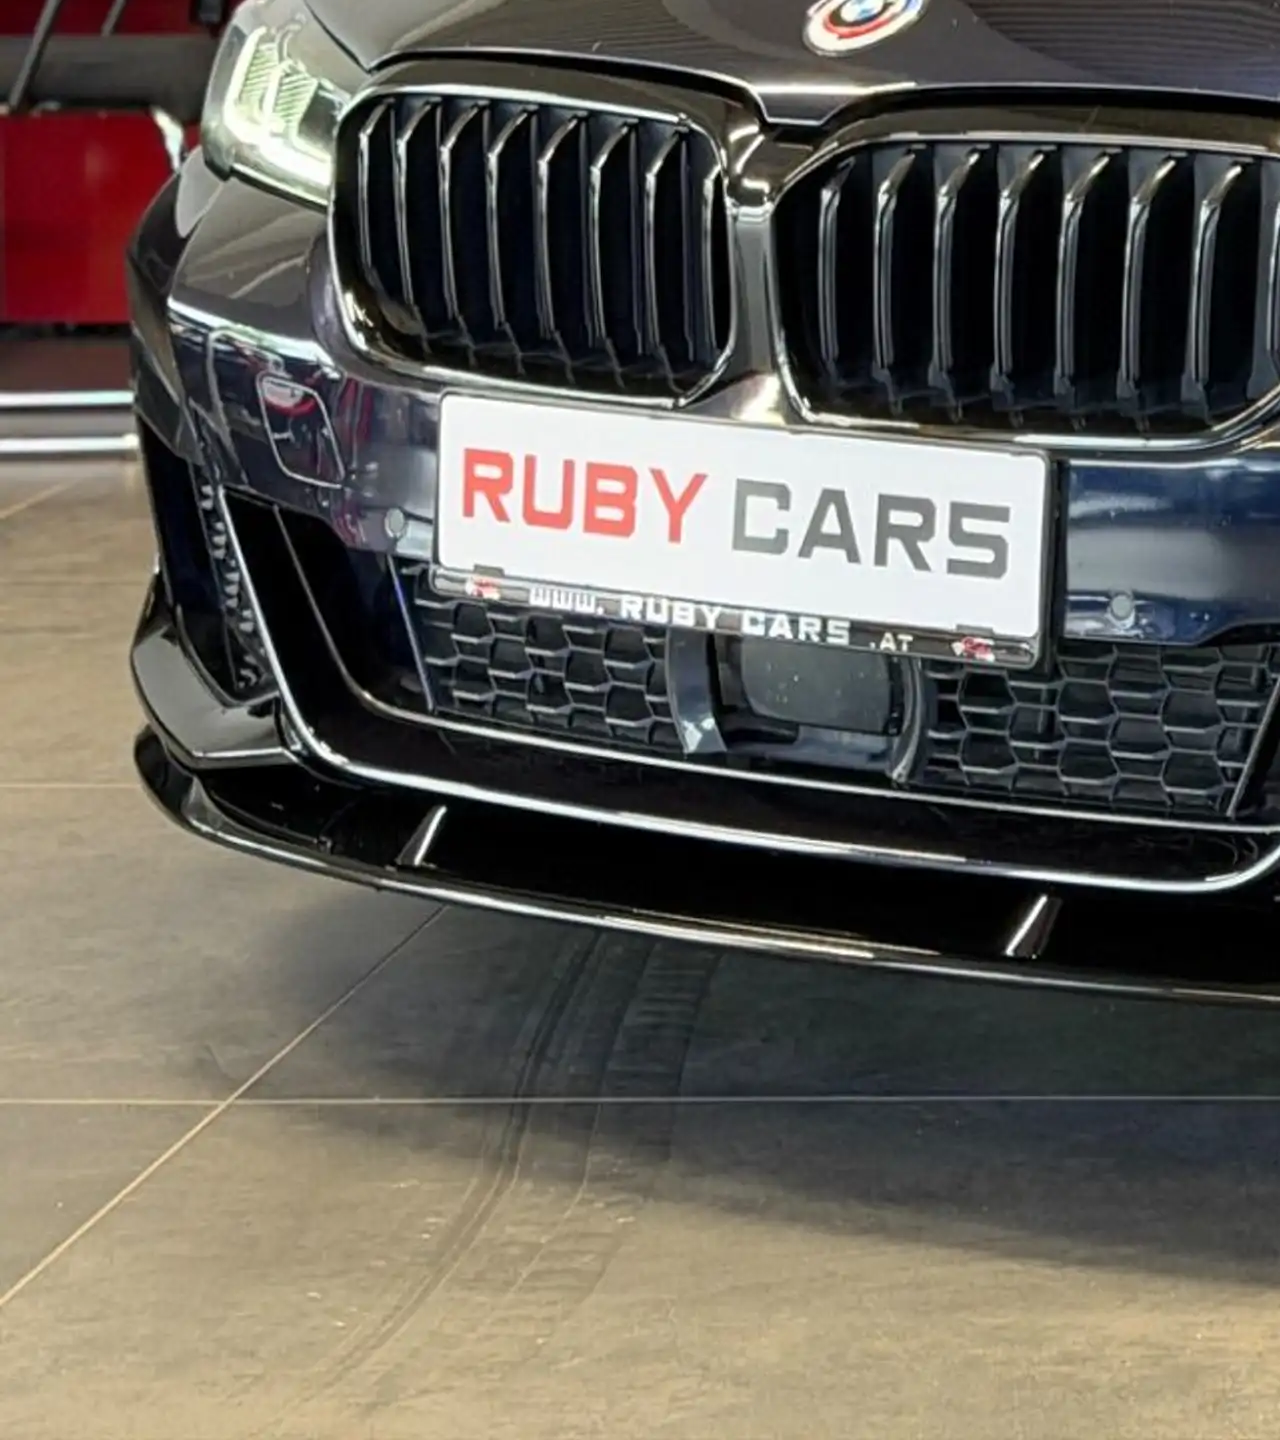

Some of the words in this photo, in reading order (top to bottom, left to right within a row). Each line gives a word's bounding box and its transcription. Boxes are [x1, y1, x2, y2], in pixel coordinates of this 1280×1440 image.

[462, 448, 709, 543] RUBY
[732, 478, 1012, 580] CARS
[620, 594, 721, 630] RUBY
[741, 612, 851, 646] CARS
